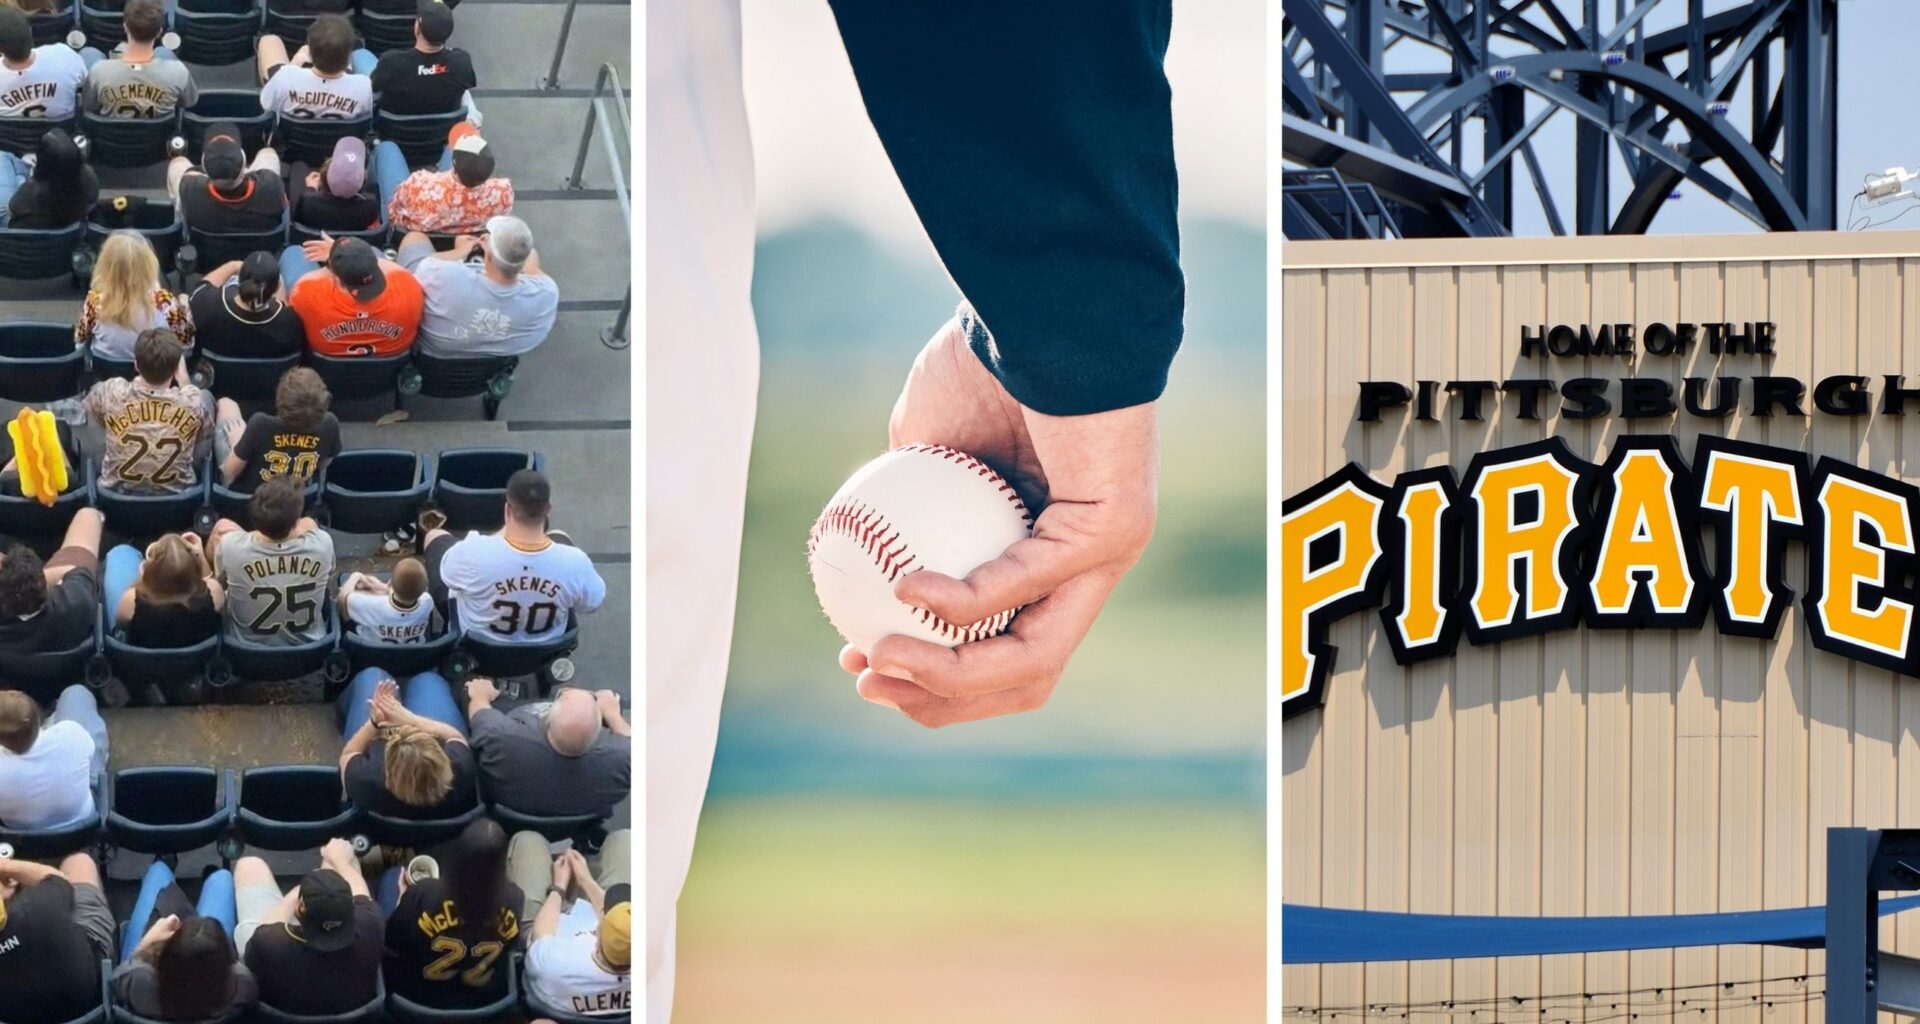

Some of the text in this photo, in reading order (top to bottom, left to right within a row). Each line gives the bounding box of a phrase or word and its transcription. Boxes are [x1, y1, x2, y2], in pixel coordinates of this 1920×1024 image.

[418, 63, 448, 76] FedEx
[1, 82, 58, 108] GRIFFIN
[103, 83, 167, 103] CLEMENTE
[289, 90, 358, 114] McCUTCHEN
[321, 320, 404, 341] HENDERSON
[1521, 321, 1777, 359] HOME OF THE
[107, 401, 199, 442] McCUTCHEN
[273, 433, 320, 449] SKENES
[119, 433, 183, 484] 22
[259, 450, 320, 482] 30
[244, 555, 321, 582] POLANCO
[495, 576, 561, 598] SKENES
[249, 582, 317, 635] 25
[489, 599, 559, 635] 30
[378, 622, 426, 638] SKENES
[422, 936, 504, 987] 22
